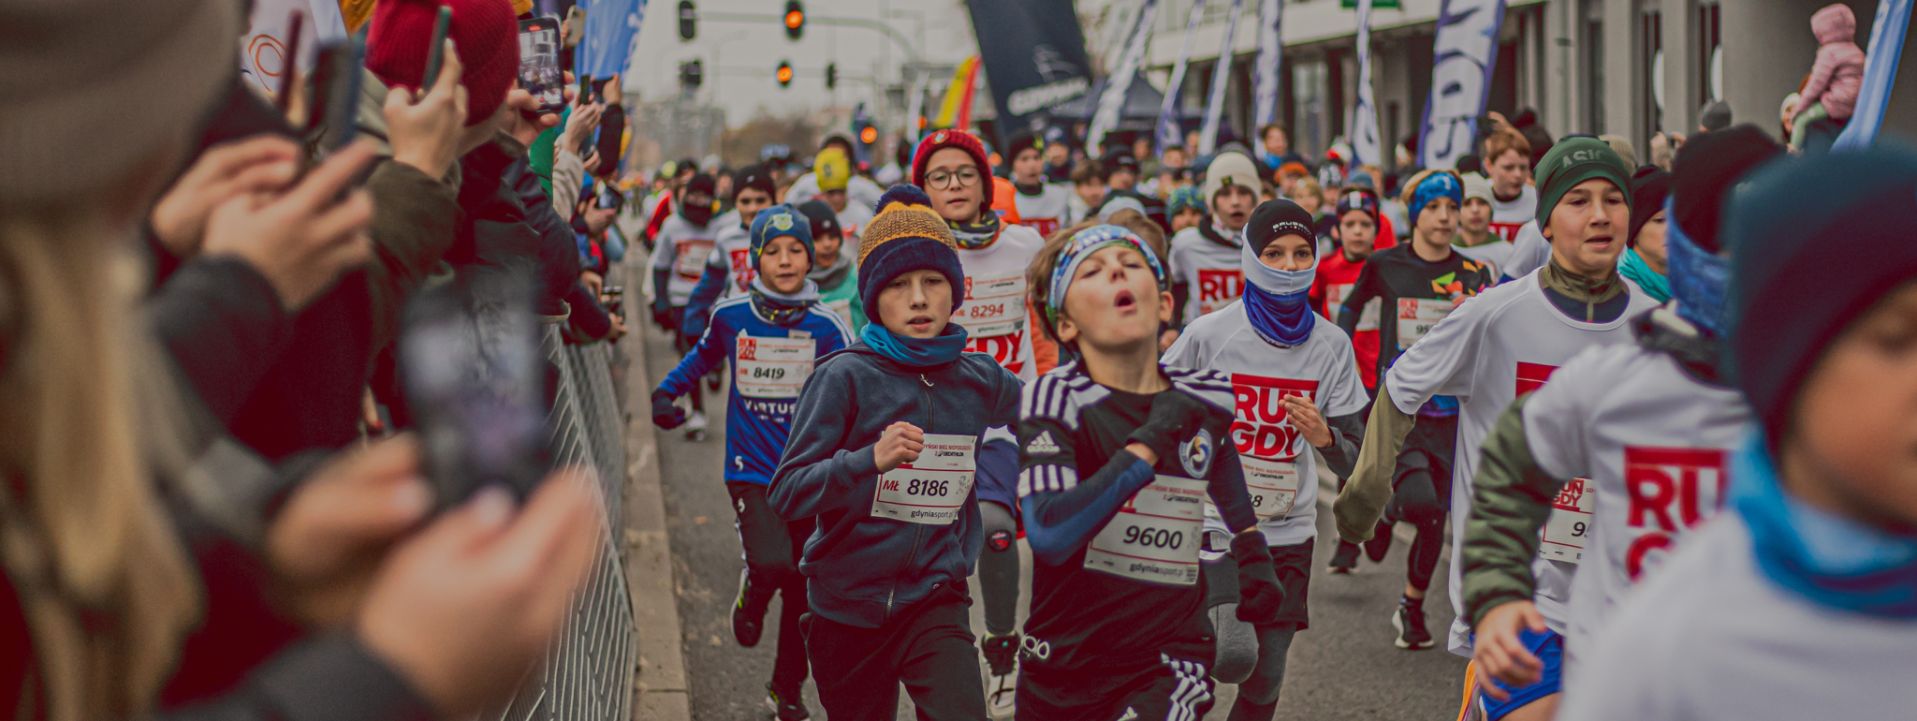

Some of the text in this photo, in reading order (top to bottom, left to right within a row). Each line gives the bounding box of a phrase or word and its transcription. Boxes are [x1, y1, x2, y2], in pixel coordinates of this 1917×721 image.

[970, 303, 1005, 319] 8294
[753, 367, 785, 379] 8419
[1229, 421, 1301, 457] GDY
[907, 479, 949, 496] 8186
[1123, 525, 1184, 550] 9600
